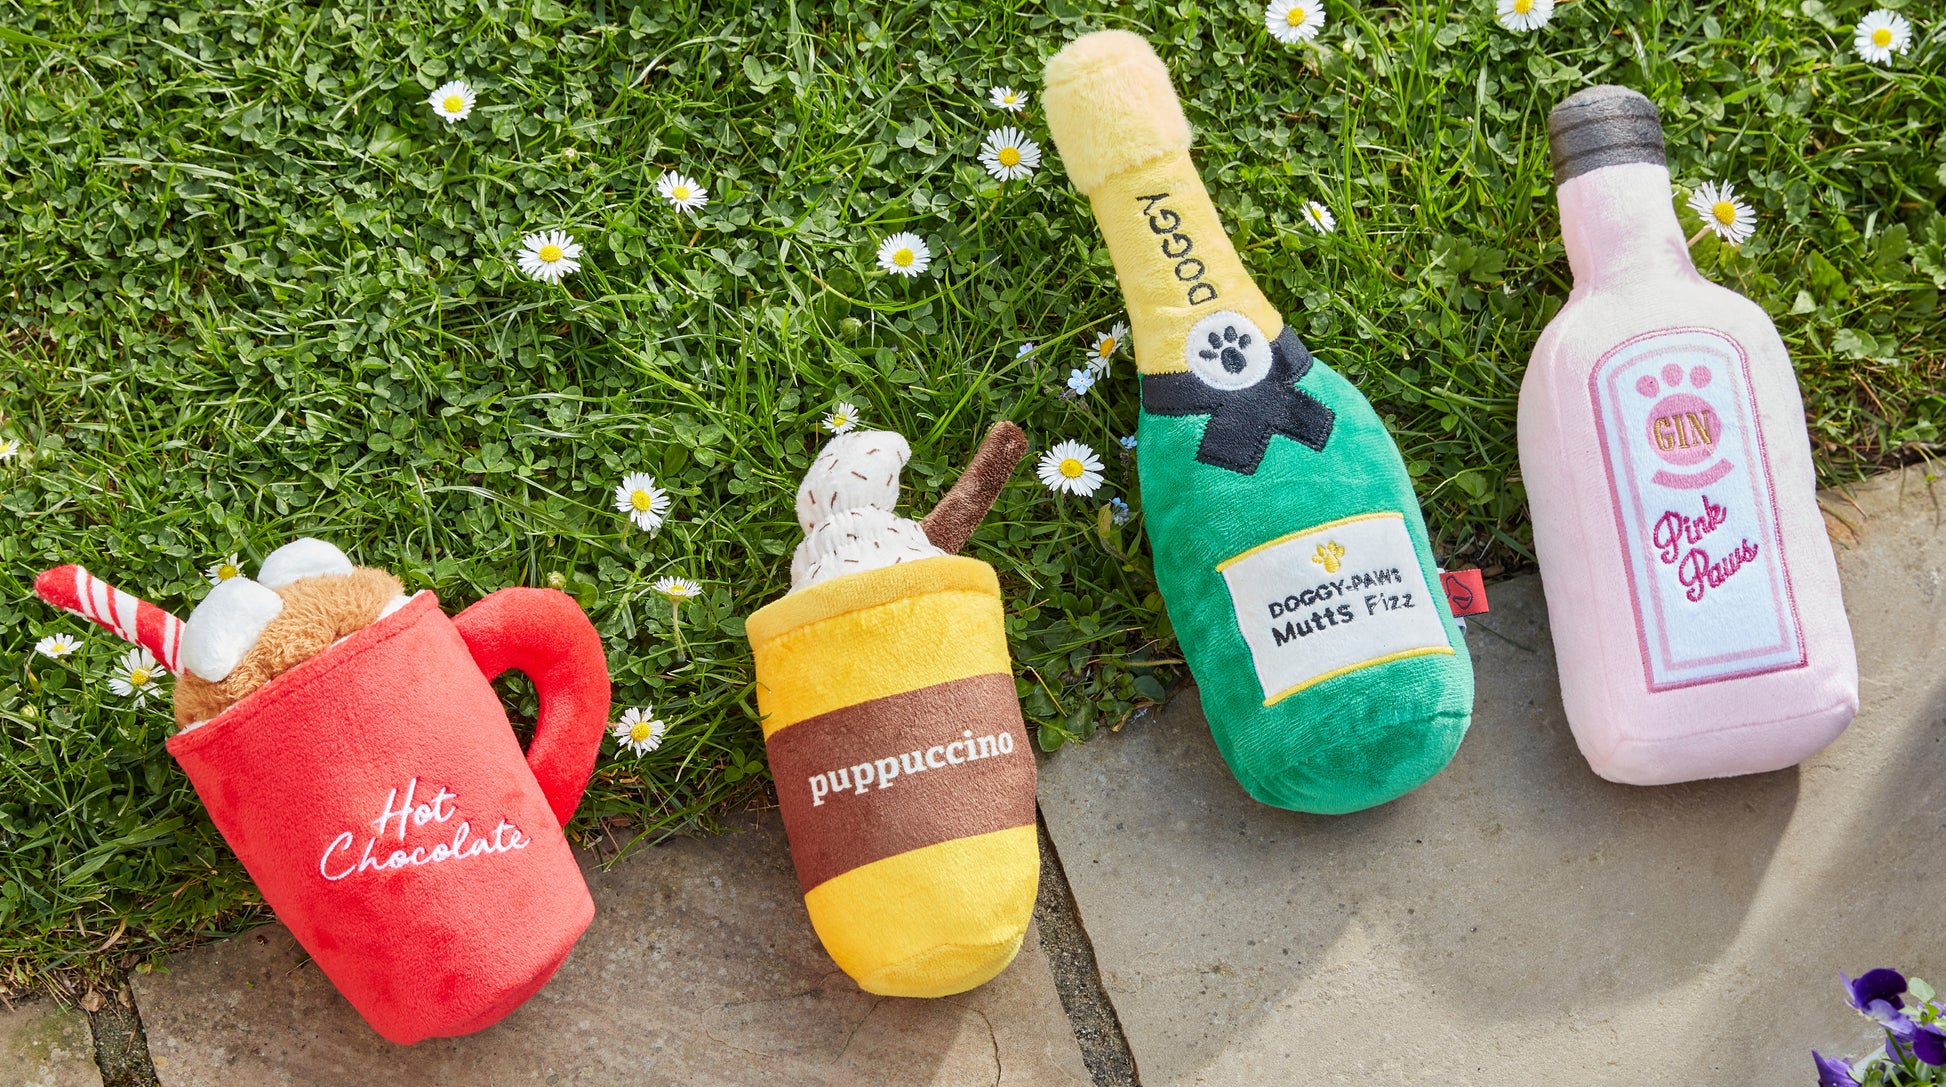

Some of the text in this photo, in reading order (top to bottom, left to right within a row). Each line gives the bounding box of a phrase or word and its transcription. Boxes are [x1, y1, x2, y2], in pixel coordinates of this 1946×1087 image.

[1135, 192, 1218, 306] DOGGY
[1652, 409, 1713, 452] GIN
[1652, 495, 1727, 564] Pink
[1268, 567, 1402, 619] DOGGY-PAWS
[1678, 538, 1758, 602] Paws
[1271, 592, 1416, 647] Mutts Fizz
[808, 729, 1014, 807] puppuccino
[372, 777, 457, 841] Hot
[320, 818, 532, 881] Chocolate
